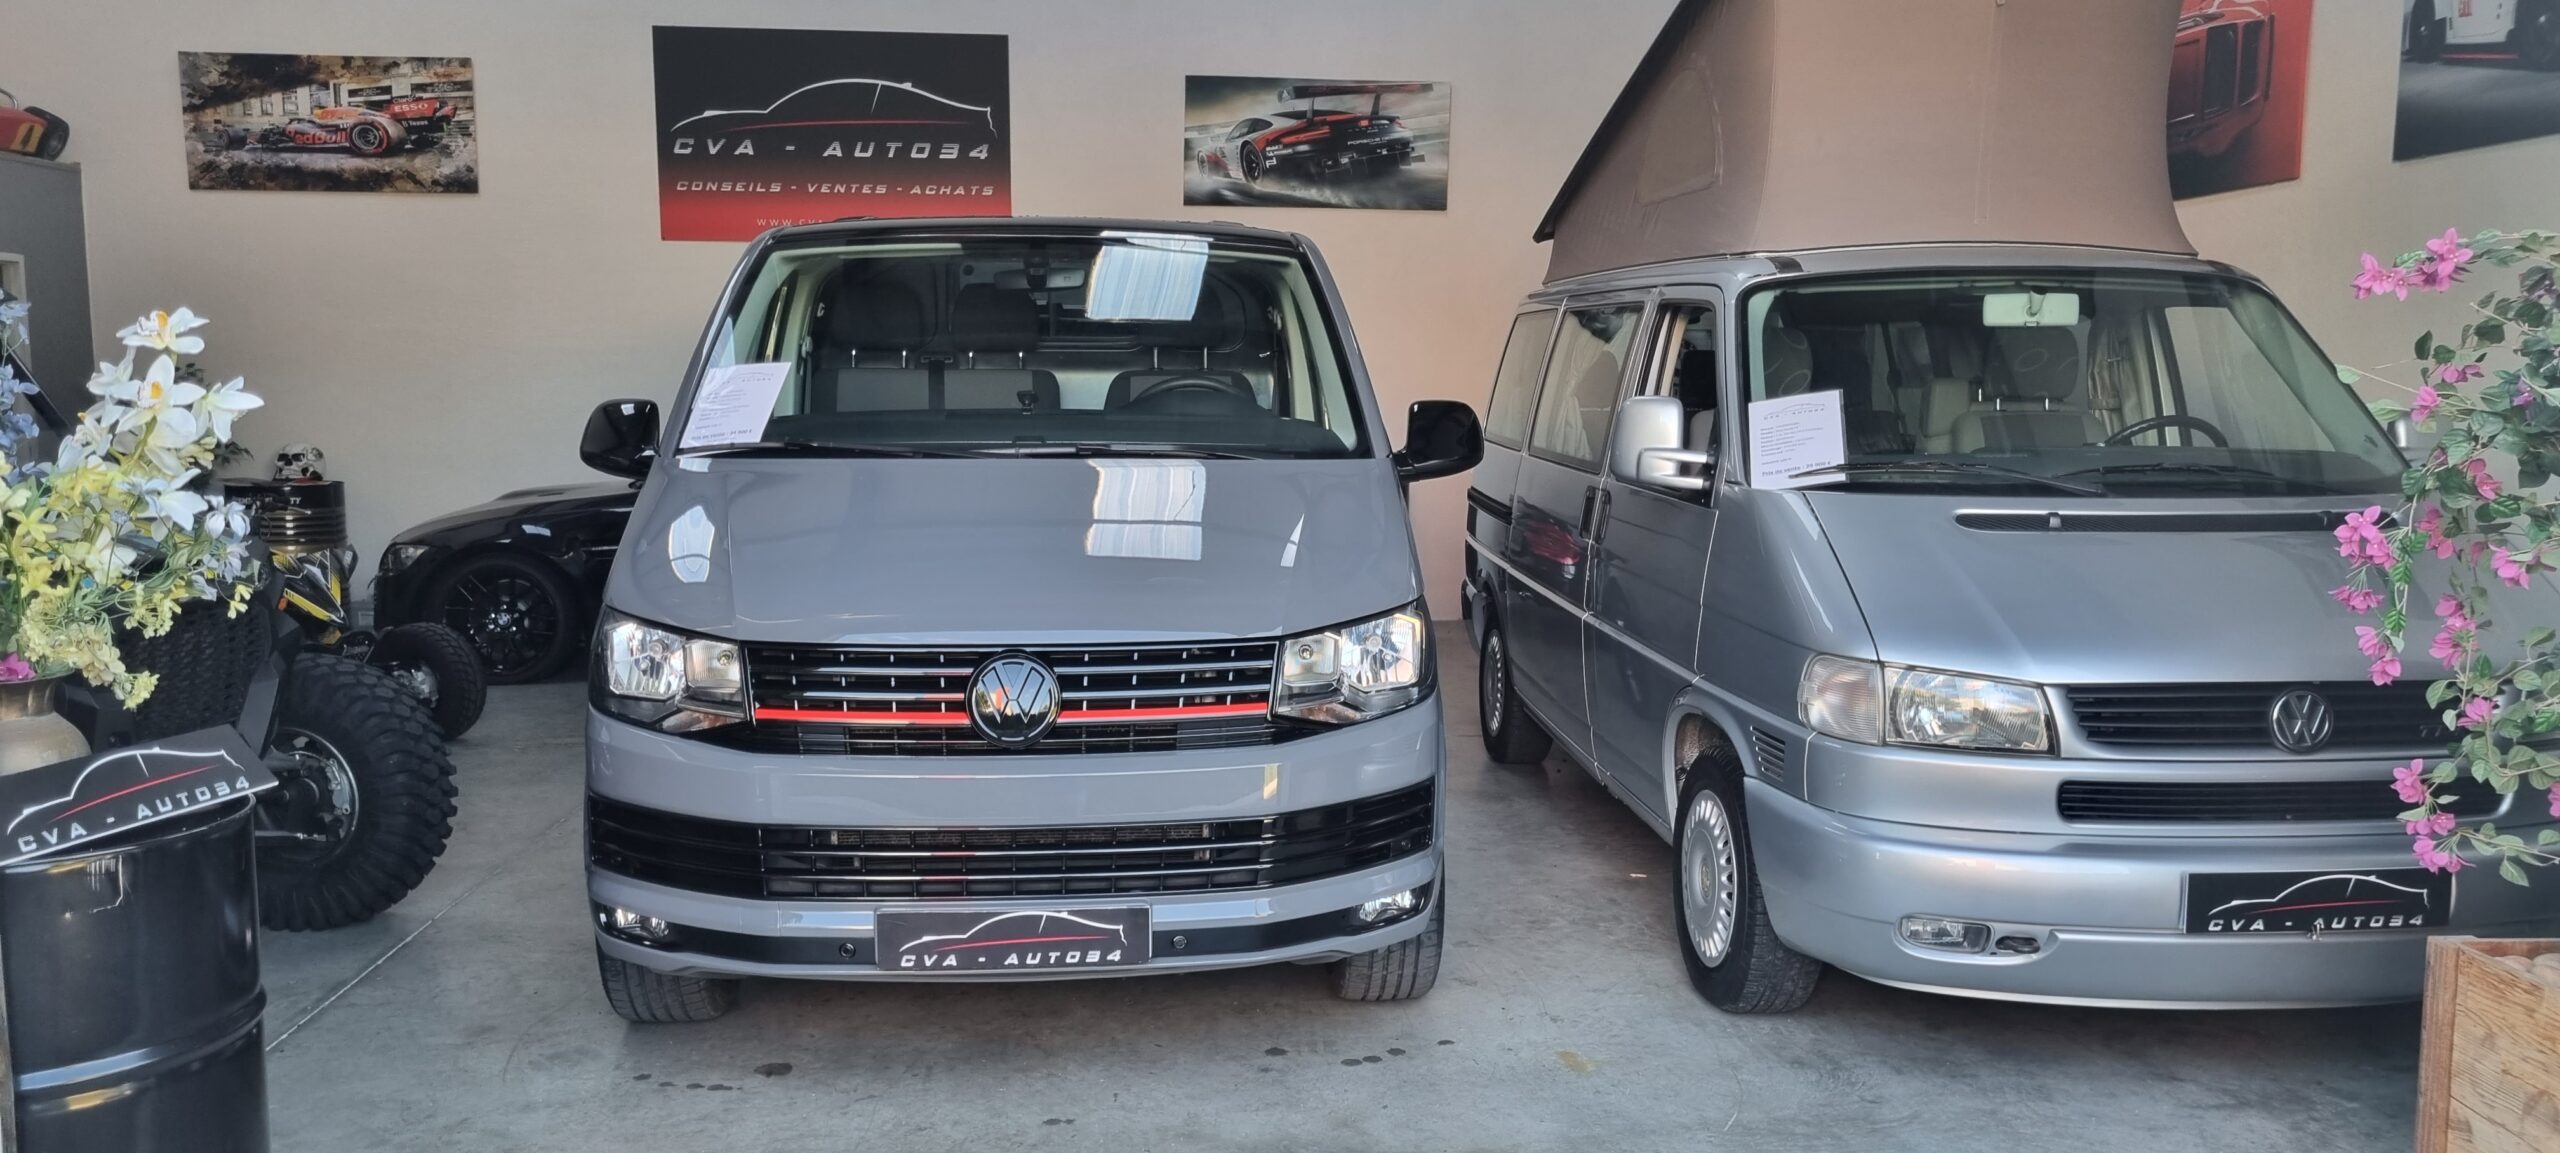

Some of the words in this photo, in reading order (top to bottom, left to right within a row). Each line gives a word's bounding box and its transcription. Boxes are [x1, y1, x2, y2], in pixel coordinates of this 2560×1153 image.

[394, 103, 428, 112] ESSO
[673, 138, 755, 156] CVA
[822, 140, 990, 160] AUTO34
[676, 180, 783, 194] CONSEILS
[807, 182, 888, 195] VENTES
[910, 184, 995, 197] ACHATS
[17, 821, 88, 854] CVA
[137, 775, 250, 821] AUTO34
[2208, 919, 2265, 932] CVA
[2312, 914, 2424, 930] AUTO34
[900, 953, 958, 967] CVA
[1004, 949, 1122, 966] AUTO34
